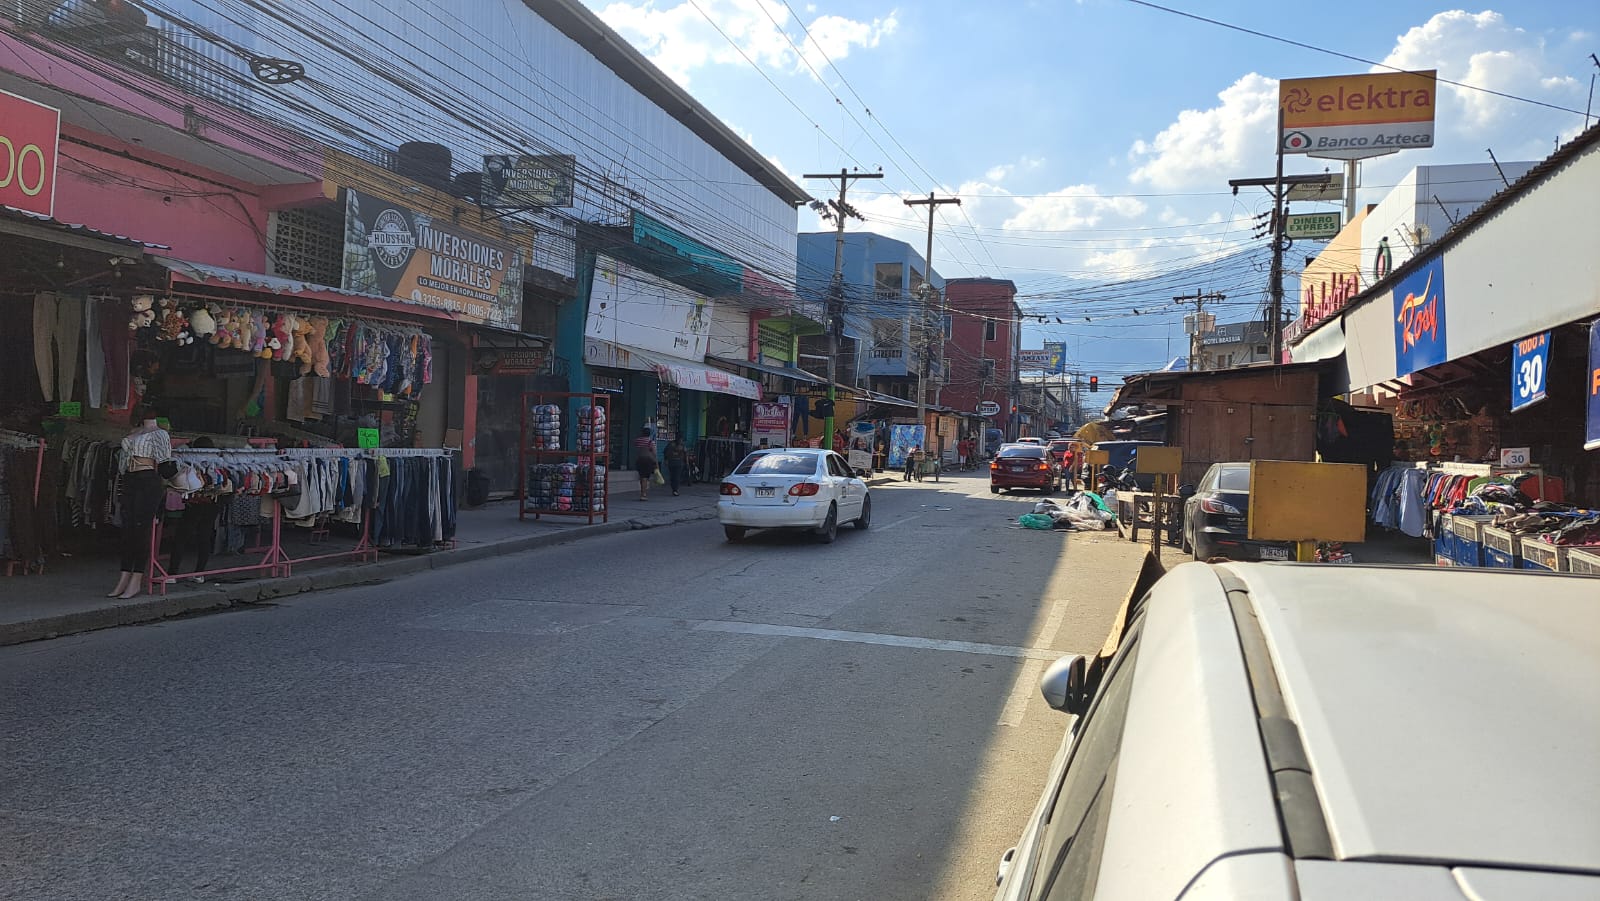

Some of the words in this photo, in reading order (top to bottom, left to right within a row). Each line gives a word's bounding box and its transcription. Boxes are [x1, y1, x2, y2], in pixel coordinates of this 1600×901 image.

[1317, 85, 1431, 112] elektra
[1317, 136, 1368, 148] Banco
[1372, 133, 1431, 146] Azteca
[509, 179, 549, 190] MORALES
[1290, 223, 1335, 232] EXPRESS
[1293, 216, 1333, 225] DINERO
[374, 233, 411, 245] HOUSTON
[418, 224, 504, 271] INVERSIONES
[430, 253, 492, 290] MORALES
[419, 277, 428, 287] LO
[429, 279, 449, 291] MEJOR
[450, 285, 458, 293] EN
[459, 287, 473, 297] ROPA
[1398, 278, 1438, 353] Rosy
[1518, 337, 1538, 357] TODO
[1538, 333, 1545, 347] A
[1520, 354, 1543, 399] 30
[1511, 454, 1525, 464] 30
